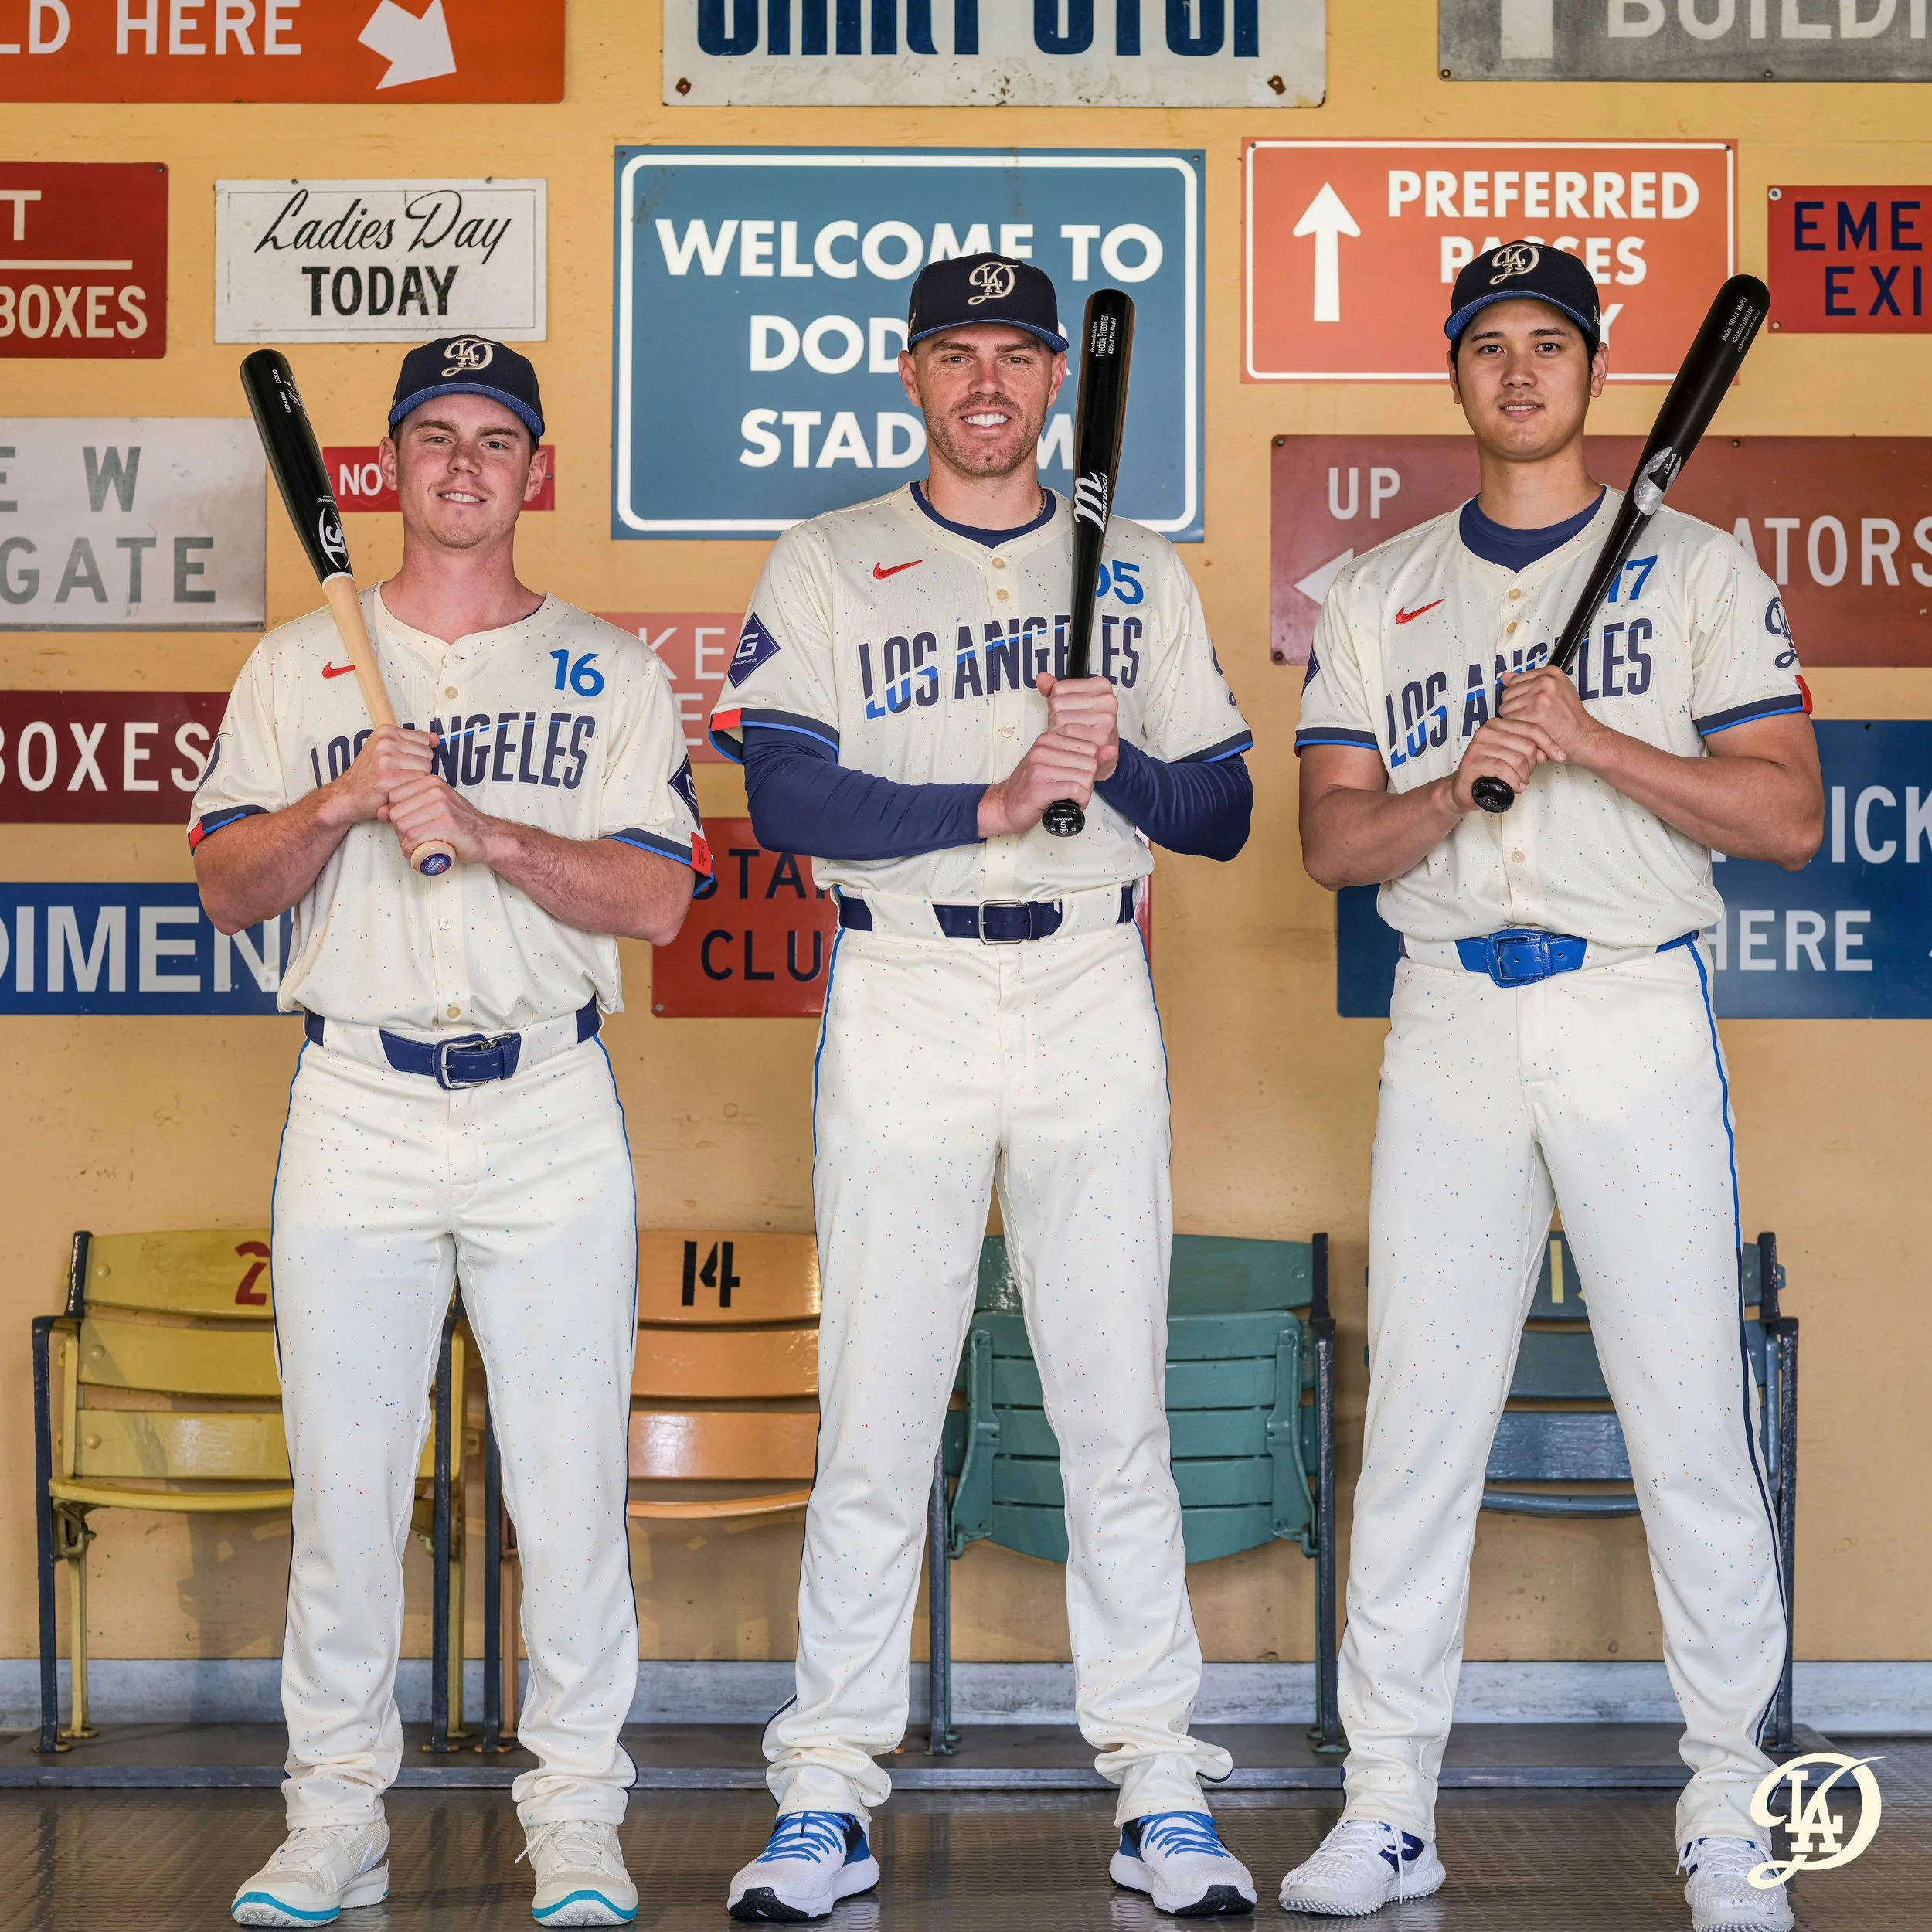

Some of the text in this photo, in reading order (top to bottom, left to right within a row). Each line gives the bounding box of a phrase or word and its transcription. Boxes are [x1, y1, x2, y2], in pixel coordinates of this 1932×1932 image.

[117, 0, 302, 55] HERE
[1389, 170, 1699, 219] PREFERRED
[253, 189, 512, 265] Ladies Day
[654, 219, 1164, 284] WELCOME TO
[1794, 201, 1923, 251] EME
[301, 265, 460, 316] TODAY
[1825, 266, 1922, 316] EXI
[1095, 314, 1110, 358] Freddie Freeman
[1720, 326, 1732, 342] Model
[1736, 295, 1749, 311] MAPLE
[1732, 323, 1746, 344] SHOHEI
[1742, 305, 1755, 325] OHTANI
[738, 408, 1075, 471] STADM
[82, 446, 141, 512] W
[339, 462, 383, 497] NO
[1328, 466, 1401, 520] UP
[0, 536, 216, 605] GATE
[736, 632, 760, 658] G
[858, 614, 1144, 721] LOS ANGEES
[549, 648, 606, 698] 16
[1385, 671, 1449, 770] LOS
[0, 720, 211, 793] OXES
[400, 711, 597, 791] NGELES
[682, 1240, 741, 1308] 14
